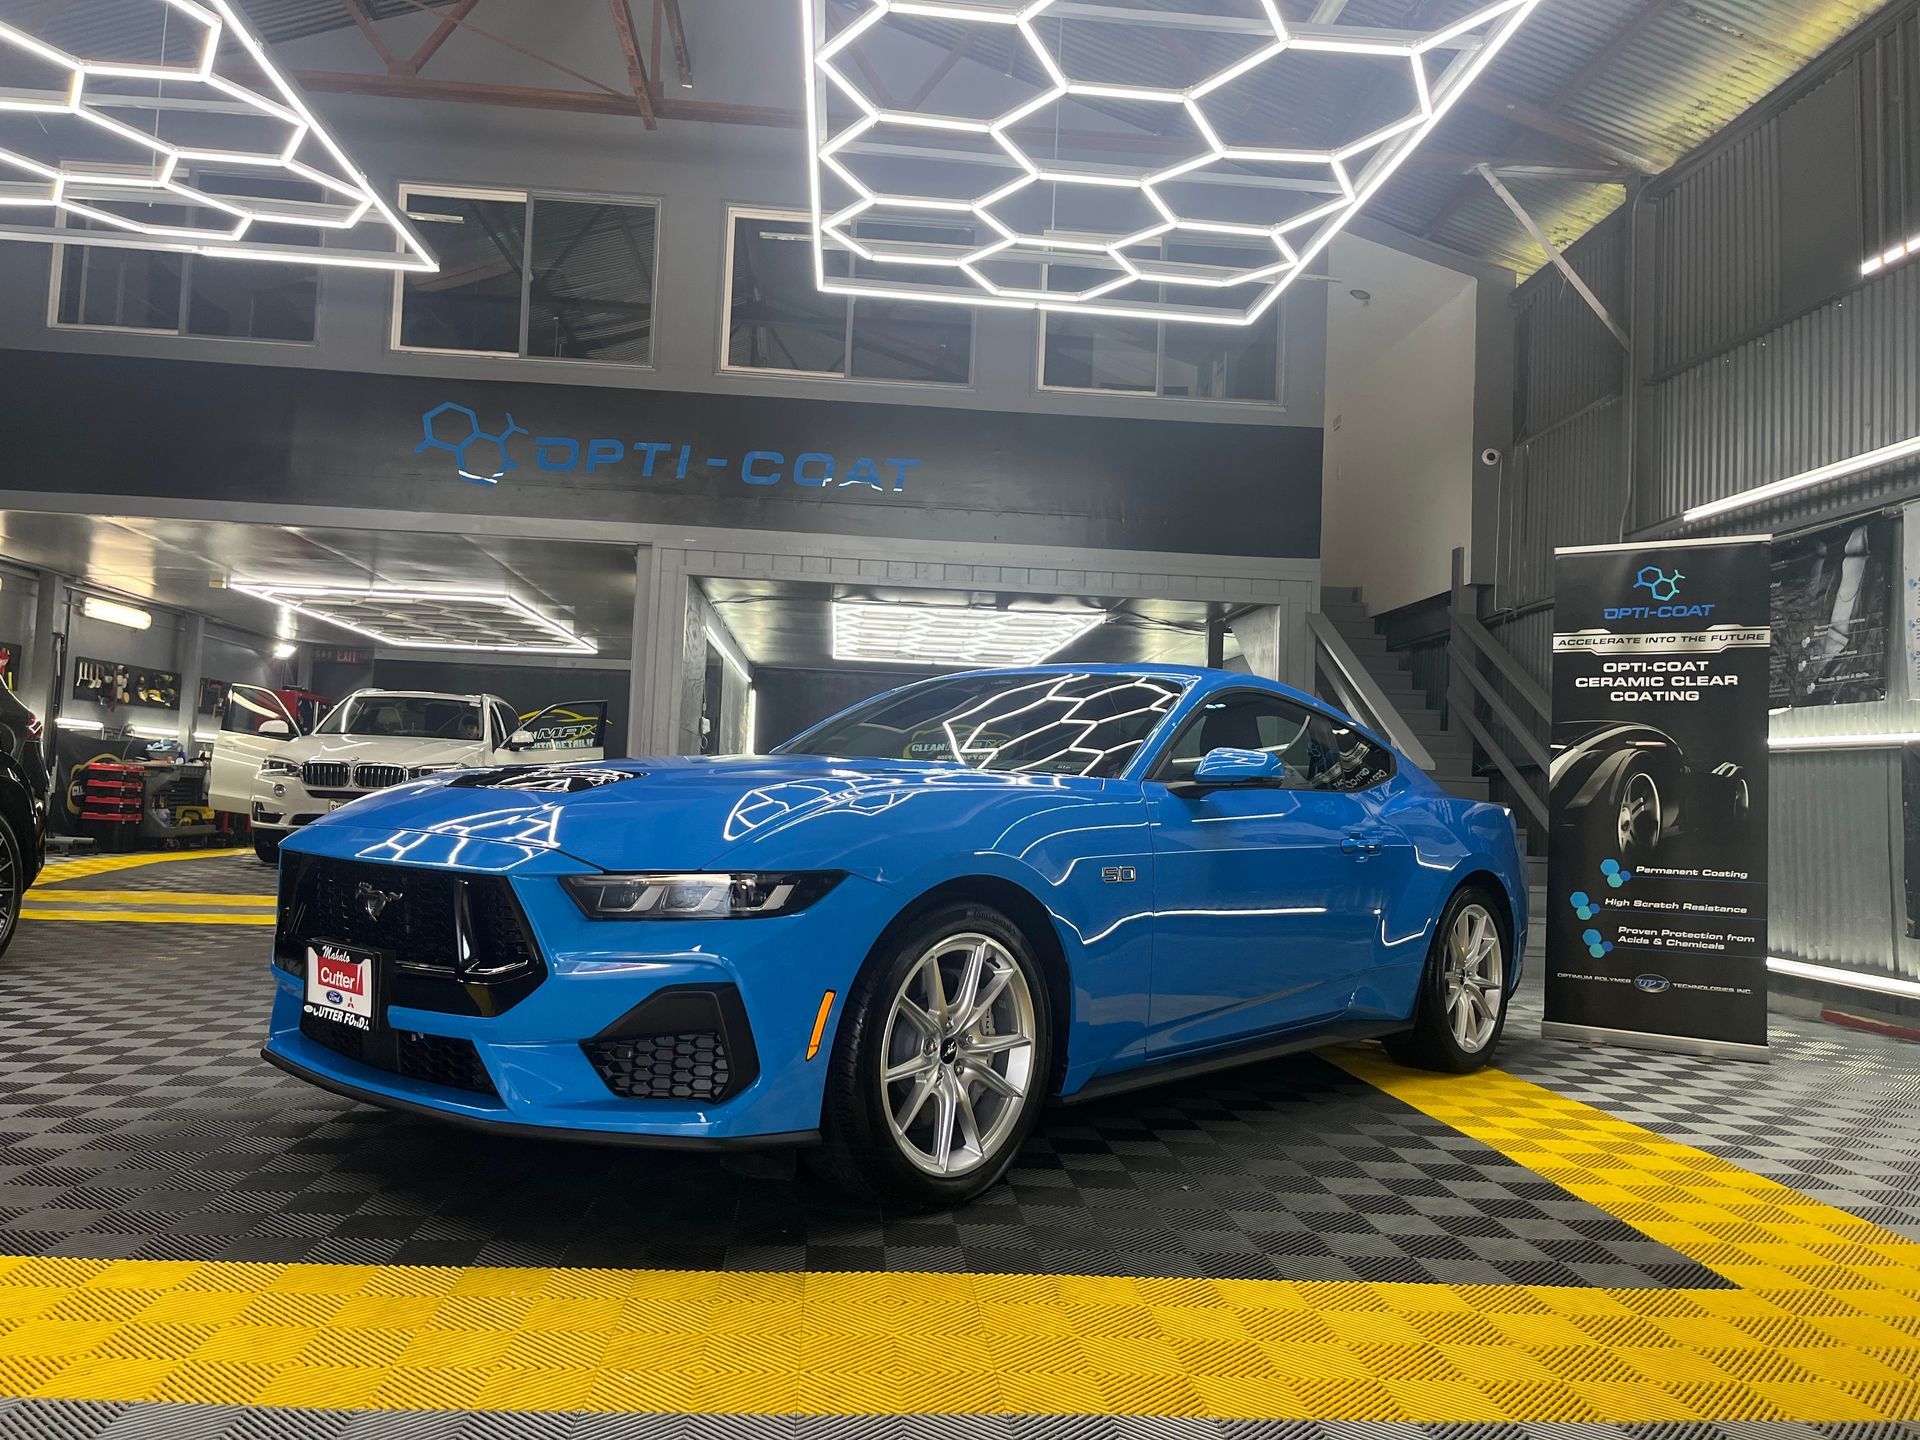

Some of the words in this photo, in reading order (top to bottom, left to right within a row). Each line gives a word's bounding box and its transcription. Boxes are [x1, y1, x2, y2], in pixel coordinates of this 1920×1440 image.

[535, 436, 923, 491] OPTI-COAT
[1603, 604, 1715, 620] OPTI-COAT
[1558, 637, 1641, 647] ACCELERATE
[1645, 635, 1676, 643] INTO
[1681, 634, 1706, 643] THE
[1710, 633, 1765, 642] FUTURE
[1602, 661, 1709, 673] OPTI-COAT
[1575, 676, 1664, 688] CERAMIC
[1671, 675, 1738, 687] CLEAR
[1610, 690, 1700, 702] COATING
[911, 743, 946, 752] CLEAN
[1635, 866, 1699, 876] Permanent
[1702, 869, 1748, 880] Coating
[1604, 898, 1630, 908] High
[1633, 899, 1679, 911] Scratch
[1683, 902, 1748, 914] Resistance
[1618, 926, 1658, 937] Proven
[1661, 929, 1723, 941] Protection
[1726, 933, 1755, 943] from
[1617, 935, 1649, 945] Acids
[1653, 937, 1662, 946] &
[1666, 938, 1725, 951] Chemicals
[321, 966, 355, 989] Cutter
[1557, 972, 1593, 980] OPTIMUM
[1594, 976, 1631, 984] POLYMER
[1672, 982, 1735, 993] TECHNOLOGIES
